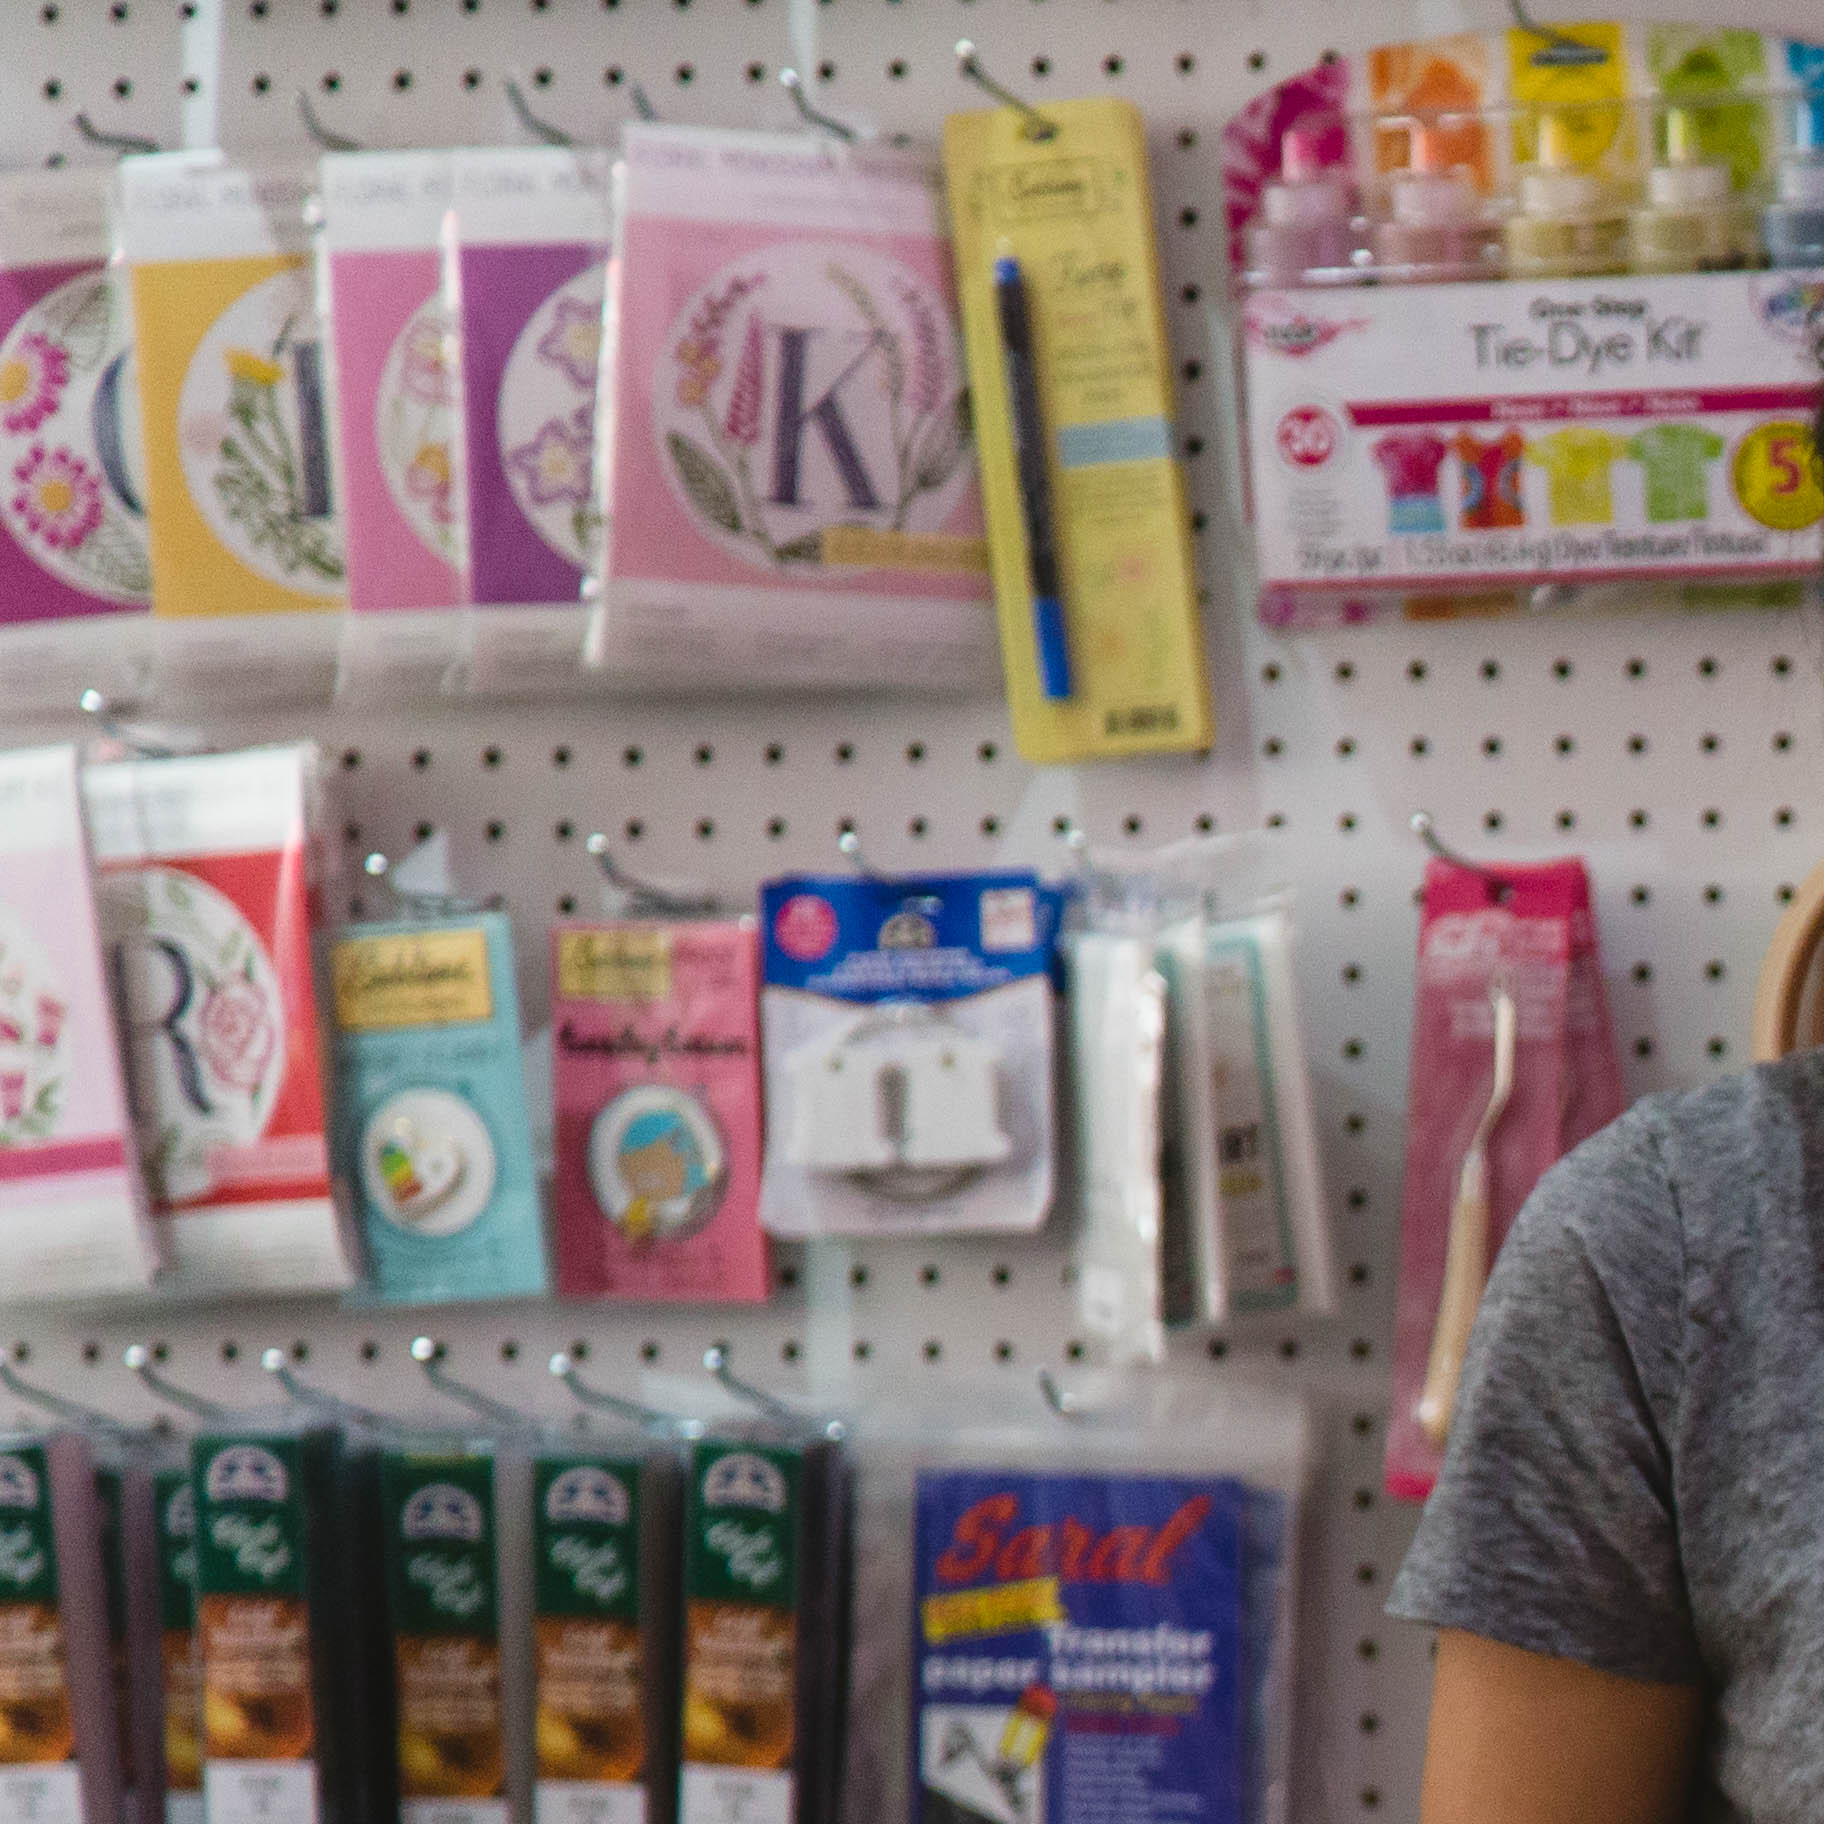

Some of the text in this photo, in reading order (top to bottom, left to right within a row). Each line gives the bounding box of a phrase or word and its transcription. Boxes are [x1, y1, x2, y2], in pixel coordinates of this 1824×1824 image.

[1468, 315, 1706, 374] Tie-Dye Kit
[768, 325, 884, 512] K
[1767, 436, 1801, 495] 5
[936, 1494, 1212, 1585] Saral
